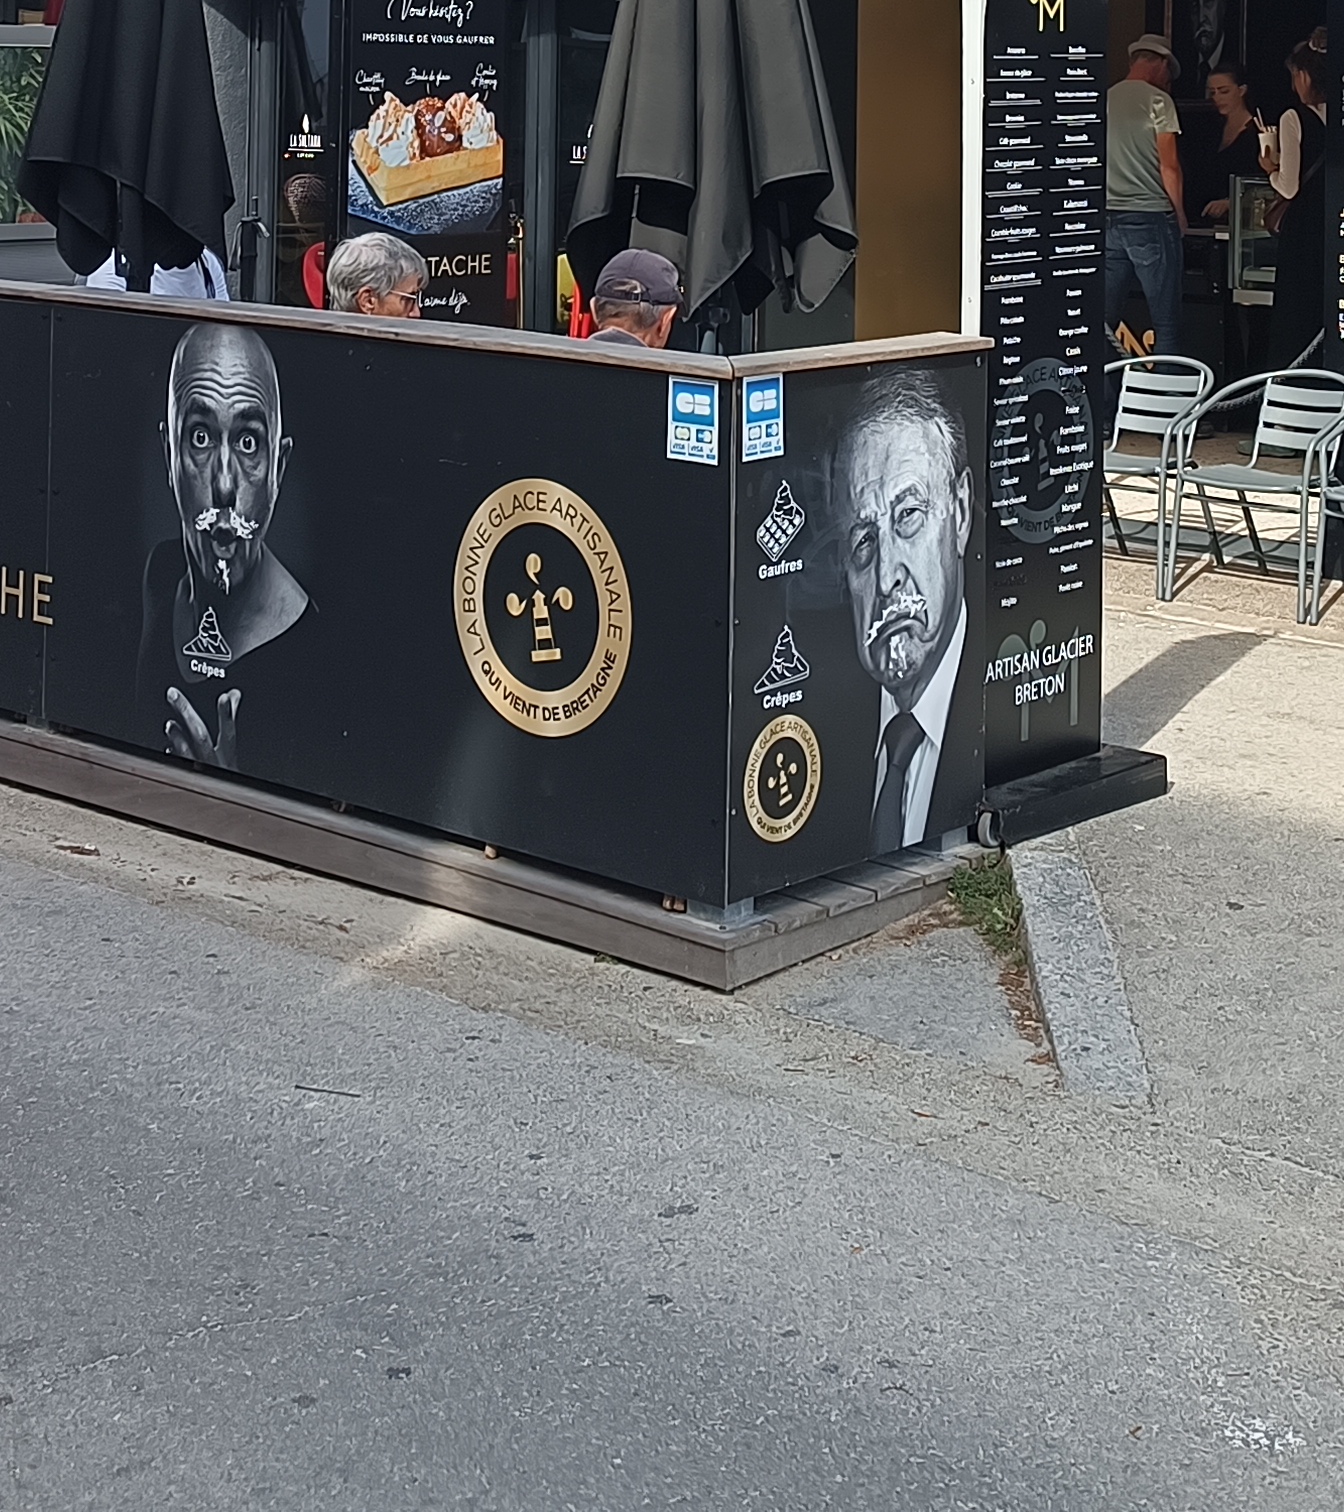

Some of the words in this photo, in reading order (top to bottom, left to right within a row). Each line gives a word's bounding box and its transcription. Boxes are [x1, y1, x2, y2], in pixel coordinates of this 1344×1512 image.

[362, 33, 414, 43] IMPOSSIBLE
[416, 33, 429, 44] DE
[431, 34, 454, 44] VOUS
[487, 491, 548, 528] GLACE
[462, 522, 493, 614] BONNE
[550, 497, 624, 642] ARTISANALE
[758, 559, 803, 579] Gaufres
[466, 618, 486, 656] LA
[190, 659, 226, 678] Crêpes
[985, 649, 1040, 683] ARTISAN
[1042, 634, 1094, 666] GLACIER
[481, 660, 504, 692] QUI
[501, 685, 540, 720] VIENT
[542, 706, 562, 722] DE
[562, 648, 618, 720] BRETAGNE
[763, 689, 803, 709] Crêpes
[1015, 672, 1065, 706] BRETON
[759, 720, 786, 750] GLACE
[787, 721, 818, 777] ARTISANALE
